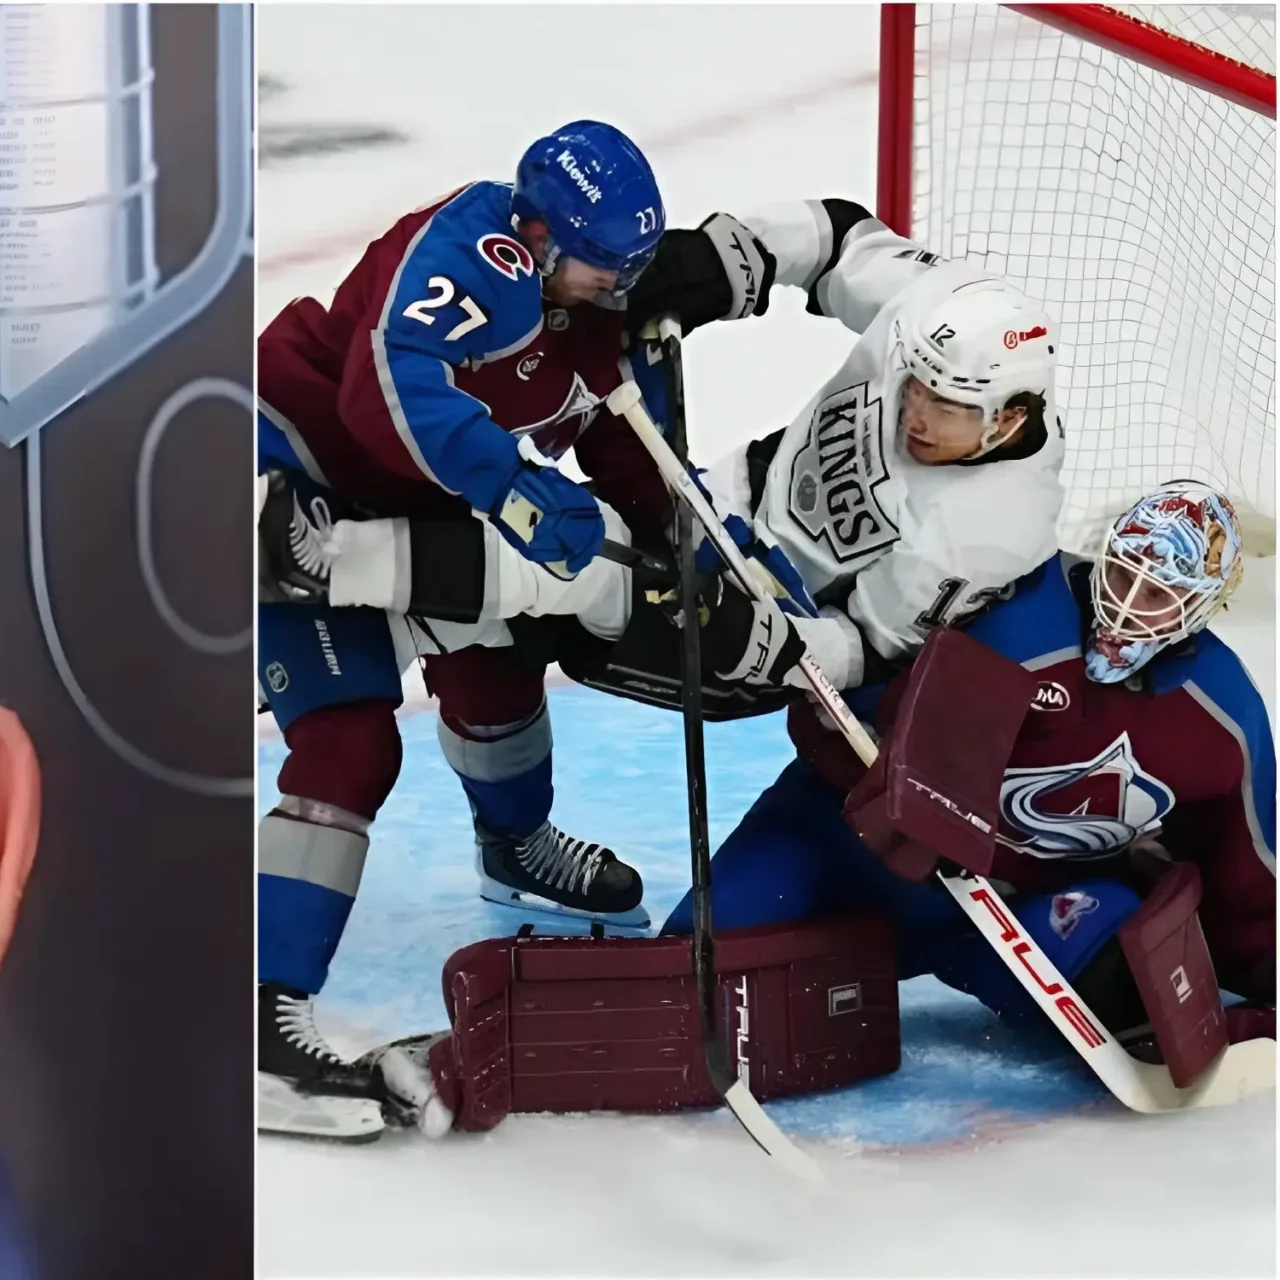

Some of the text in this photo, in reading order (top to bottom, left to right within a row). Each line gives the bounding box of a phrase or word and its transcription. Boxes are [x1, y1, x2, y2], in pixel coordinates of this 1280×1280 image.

[402, 275, 489, 342] 27
[930, 323, 957, 349] 12
[818, 397, 882, 547] KINGS
[969, 888, 1108, 1049] RUE
